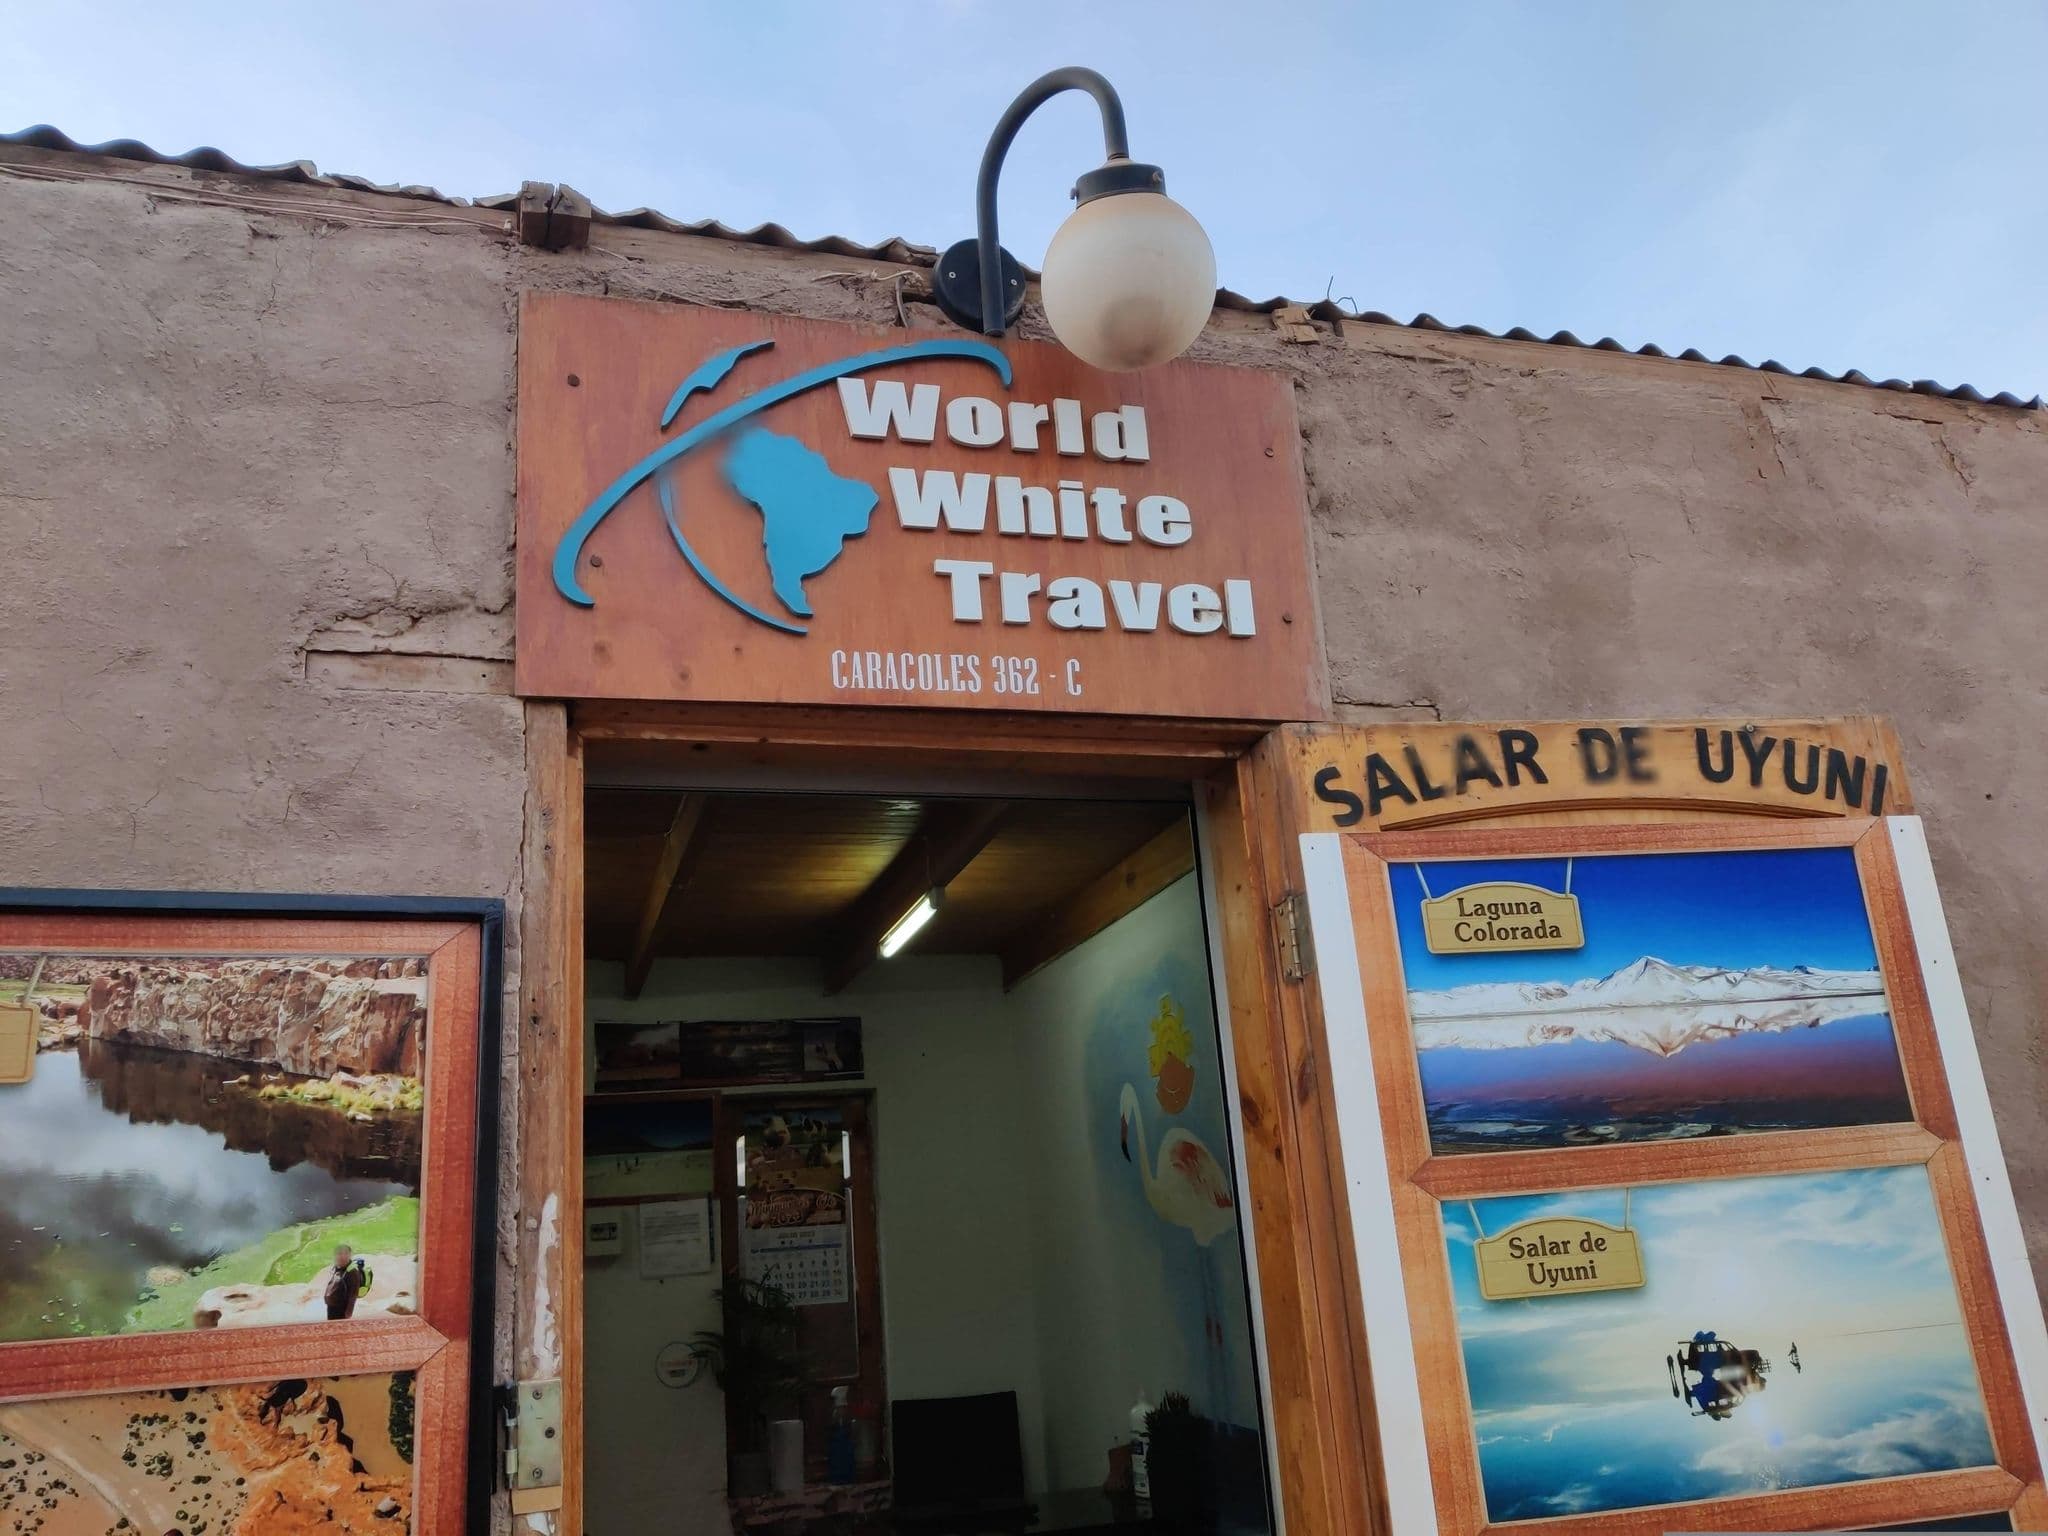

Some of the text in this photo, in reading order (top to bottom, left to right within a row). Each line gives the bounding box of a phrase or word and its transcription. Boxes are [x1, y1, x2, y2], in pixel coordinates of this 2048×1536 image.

[837, 377, 1150, 463] World
[888, 467, 1192, 547] White
[933, 559, 1257, 638] Travel
[831, 650, 982, 693] CARACOLES
[991, 655, 1040, 694] 362
[1066, 658, 1082, 695] C
[1313, 726, 1889, 827] SALAR DE UYUNI
[1454, 919, 1562, 942] Colorada
[1456, 898, 1543, 920] Laguna
[1508, 1232, 1607, 1259] Salar de
[1527, 1260, 1598, 1288] Uyuni
